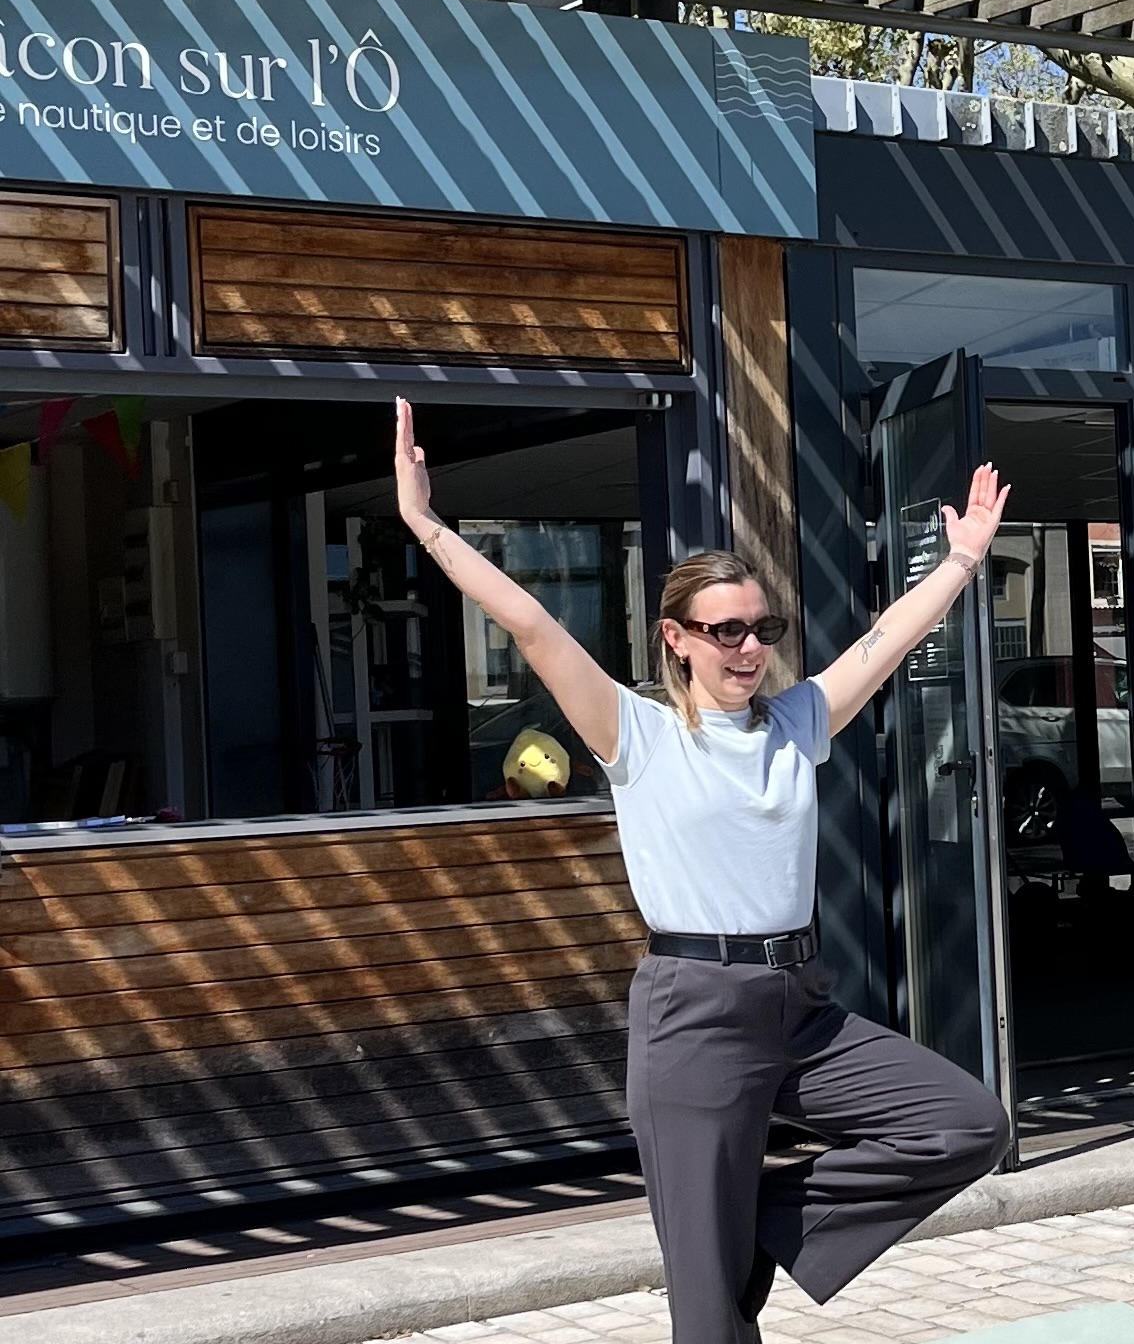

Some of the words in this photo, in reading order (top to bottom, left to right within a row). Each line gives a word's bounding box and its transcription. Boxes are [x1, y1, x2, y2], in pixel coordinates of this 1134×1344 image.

[179, 48, 287, 102] sur
[307, 28, 400, 113] l'Ô
[18, 102, 182, 144] nautique
[192, 115, 226, 143] et
[236, 117, 280, 147] de
[291, 120, 381, 156] loisirs
